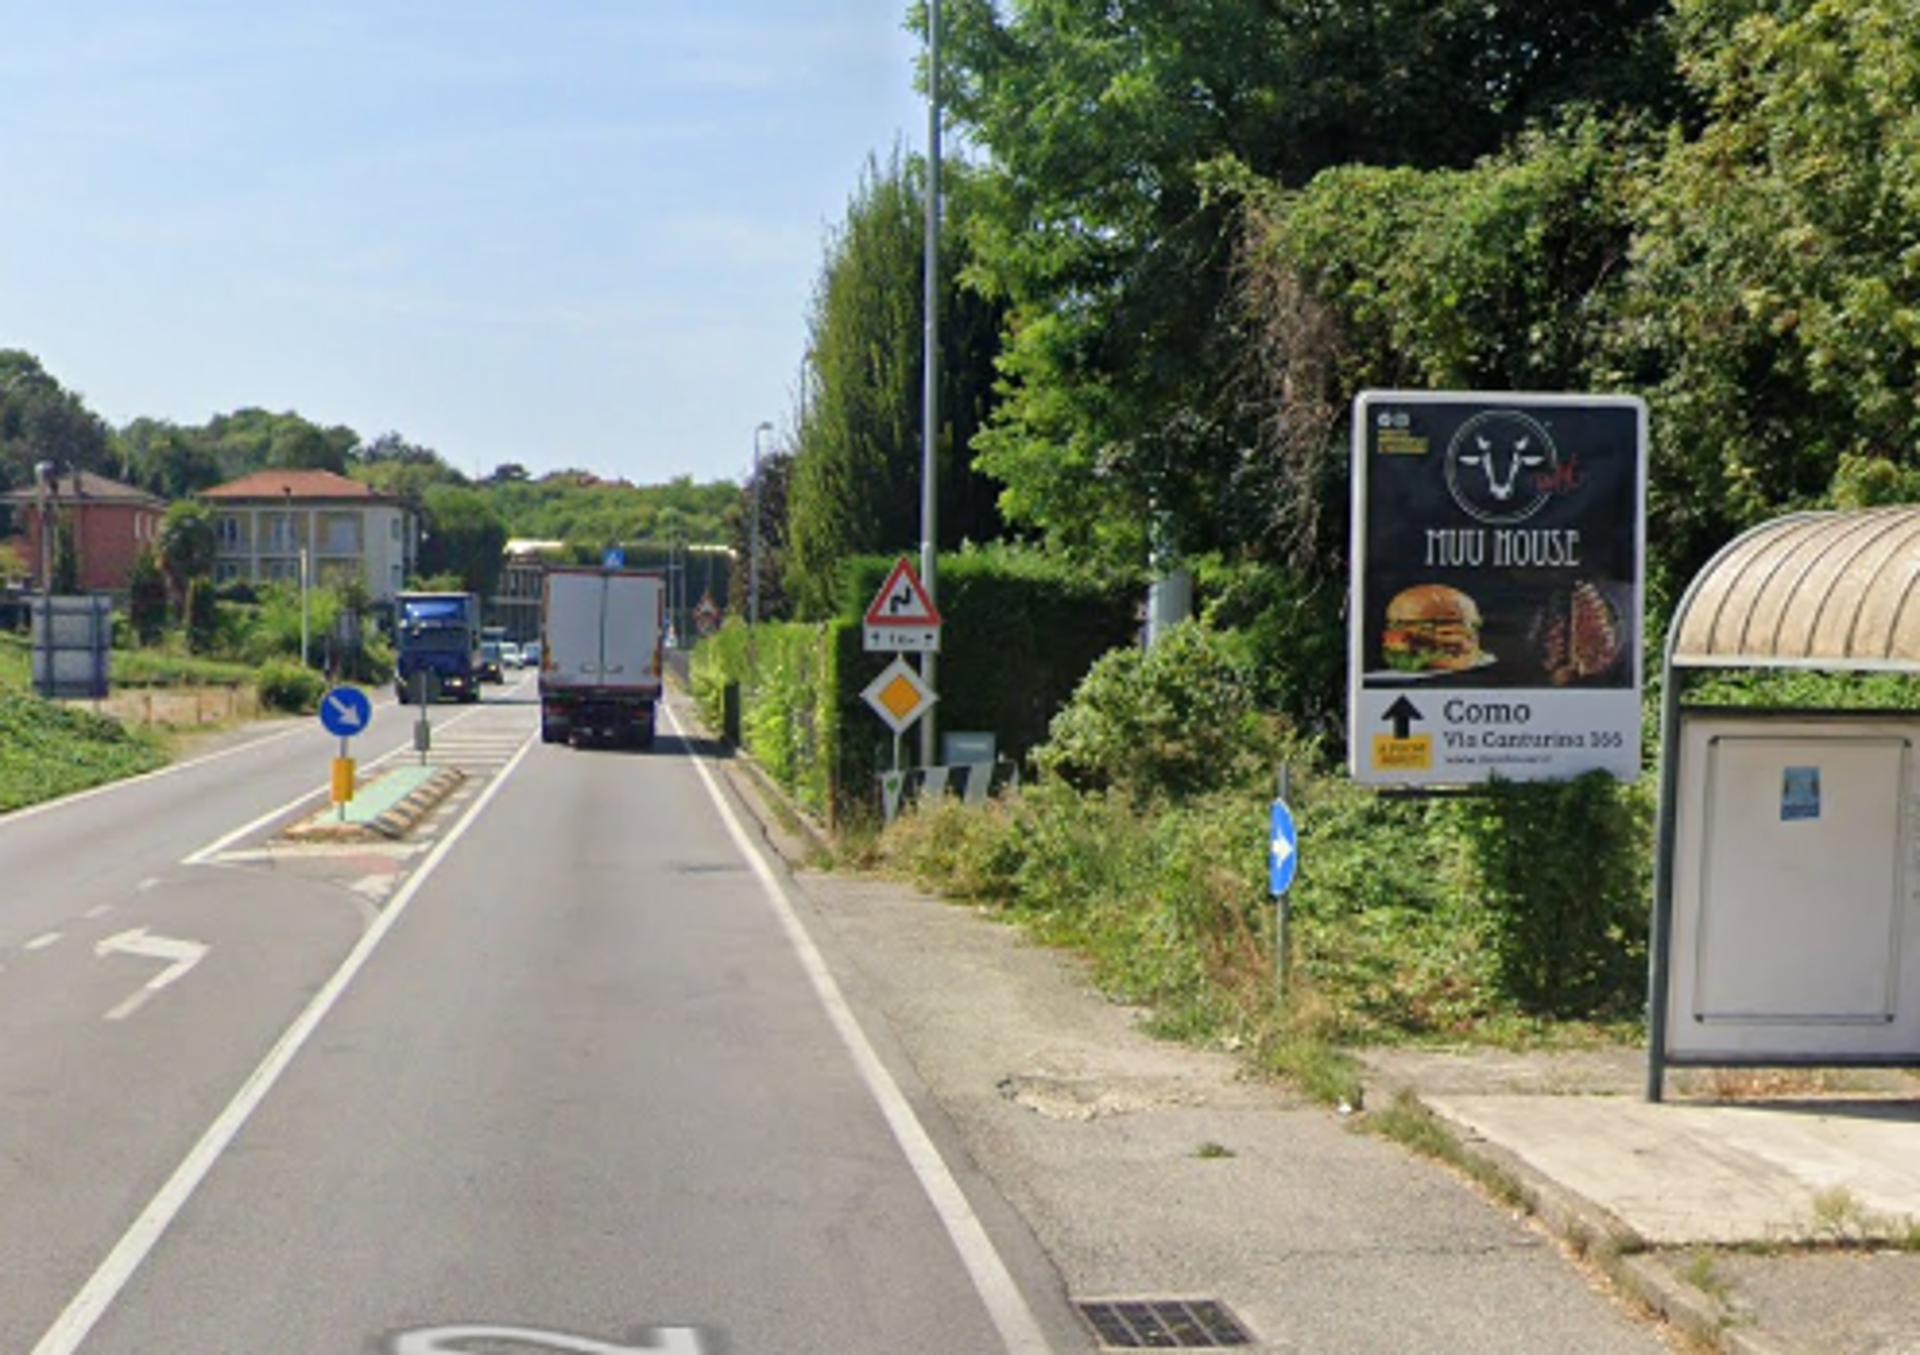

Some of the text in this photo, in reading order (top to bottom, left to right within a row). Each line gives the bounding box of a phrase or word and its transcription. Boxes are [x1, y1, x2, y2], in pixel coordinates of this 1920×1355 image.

[1424, 528, 1581, 566] MUU HOUSE
[1443, 699, 1531, 724] Como
[1443, 730, 1477, 747] Via
